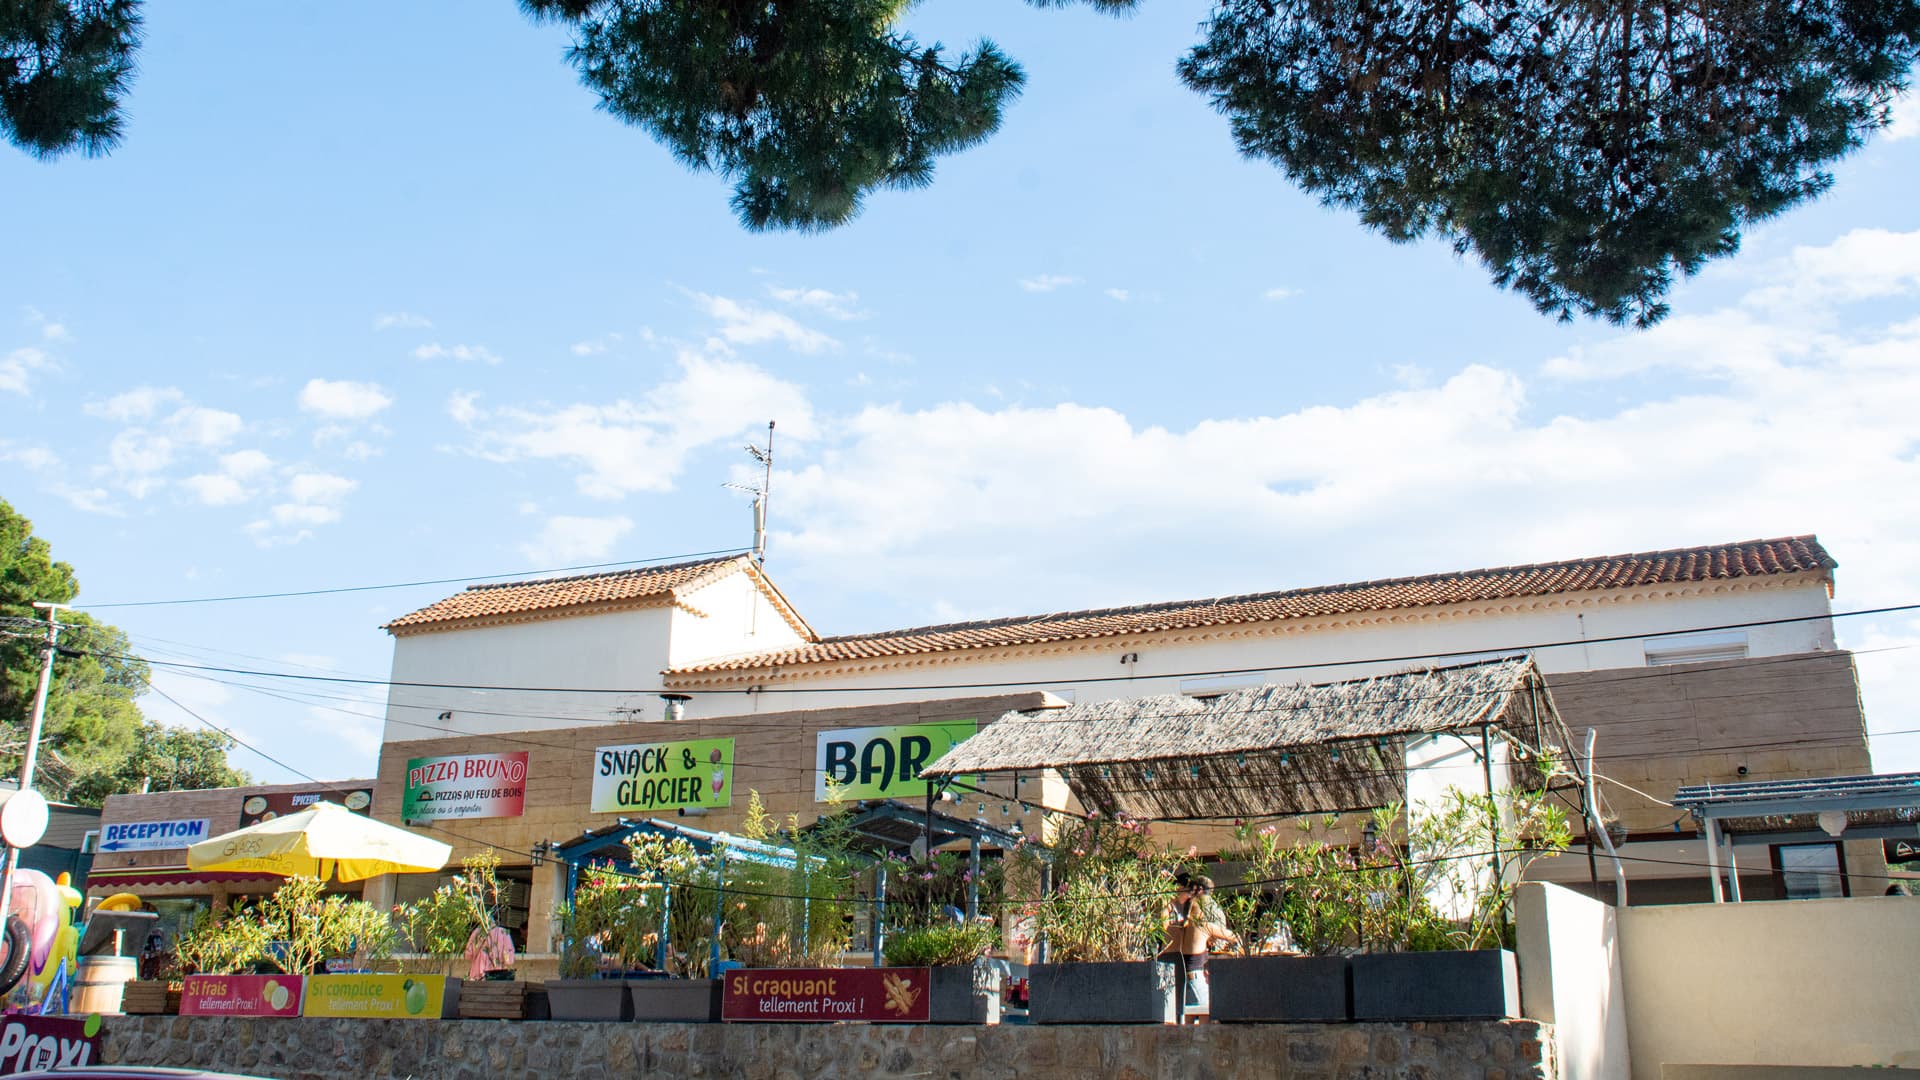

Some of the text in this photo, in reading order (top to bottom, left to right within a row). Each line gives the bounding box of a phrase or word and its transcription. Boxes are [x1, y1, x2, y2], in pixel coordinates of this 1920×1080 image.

[600, 748, 697, 778] SNACK &
[825, 735, 931, 792] BAR
[410, 759, 525, 789] PIZZA BRUNO
[435, 787, 522, 801] PIZZAS AU FEU DE BOIS
[617, 777, 702, 808] GLACIER
[106, 821, 203, 840] RECEPTION
[188, 979, 228, 996] Si frais
[311, 980, 384, 997] Si complice
[733, 976, 837, 999] Si craquant
[199, 997, 234, 1010] tellement
[329, 998, 368, 1011] tellement
[370, 997, 393, 1011] Proxi
[759, 996, 818, 1013] tellement
[822, 998, 856, 1014] Proxi
